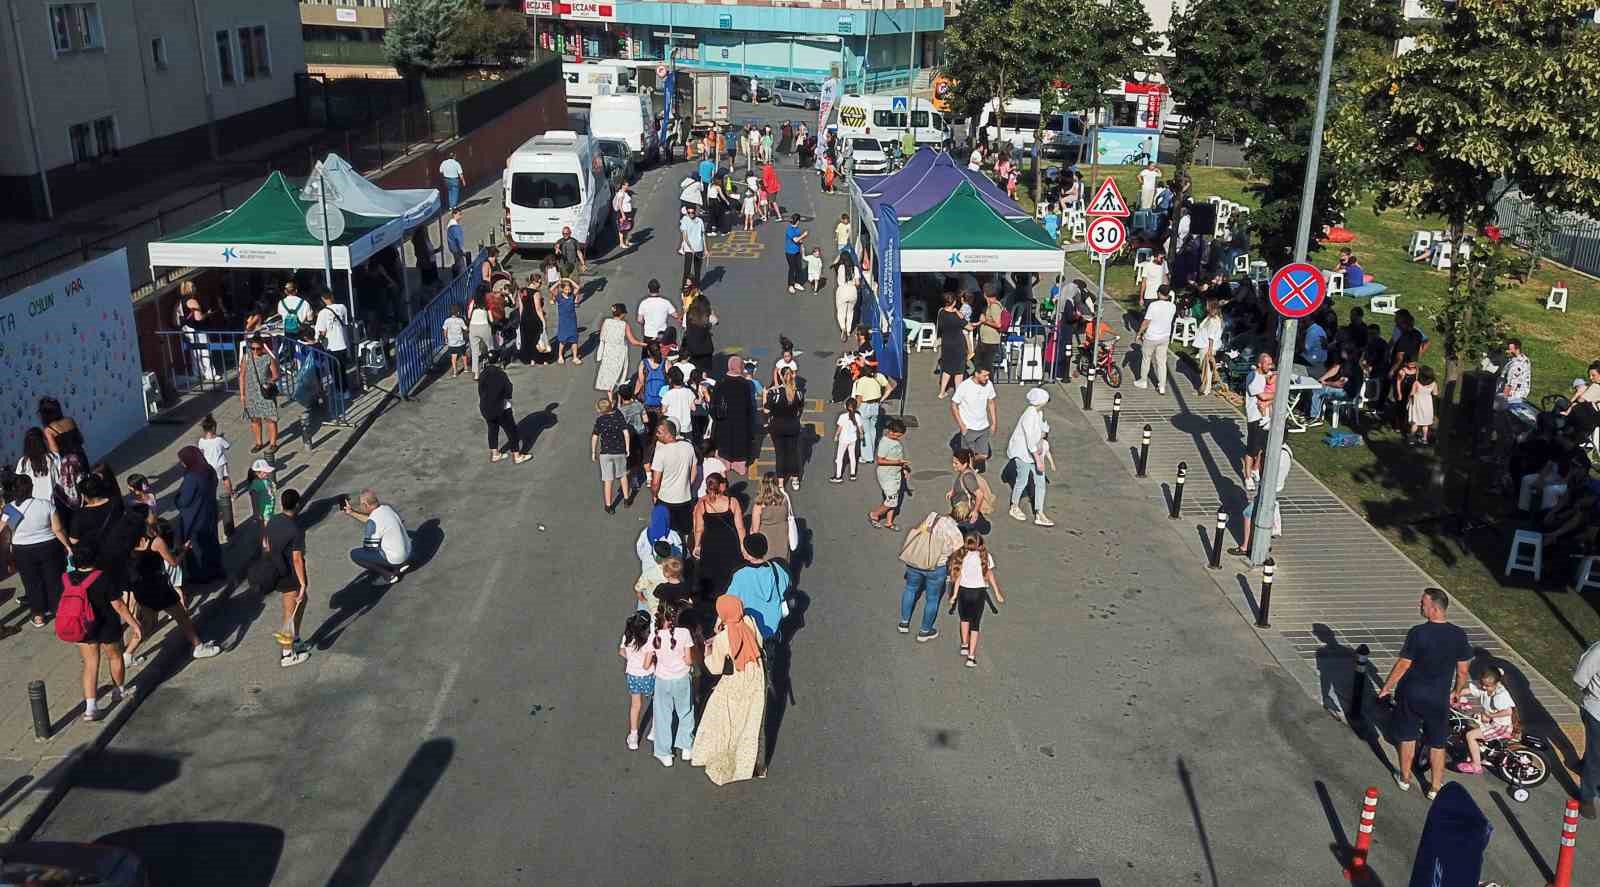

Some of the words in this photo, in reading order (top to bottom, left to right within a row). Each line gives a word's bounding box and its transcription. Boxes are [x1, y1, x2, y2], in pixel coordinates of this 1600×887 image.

[572, 3, 598, 12] ECZANE
[1095, 226, 1118, 243] 30
[64, 278, 84, 297] VAR
